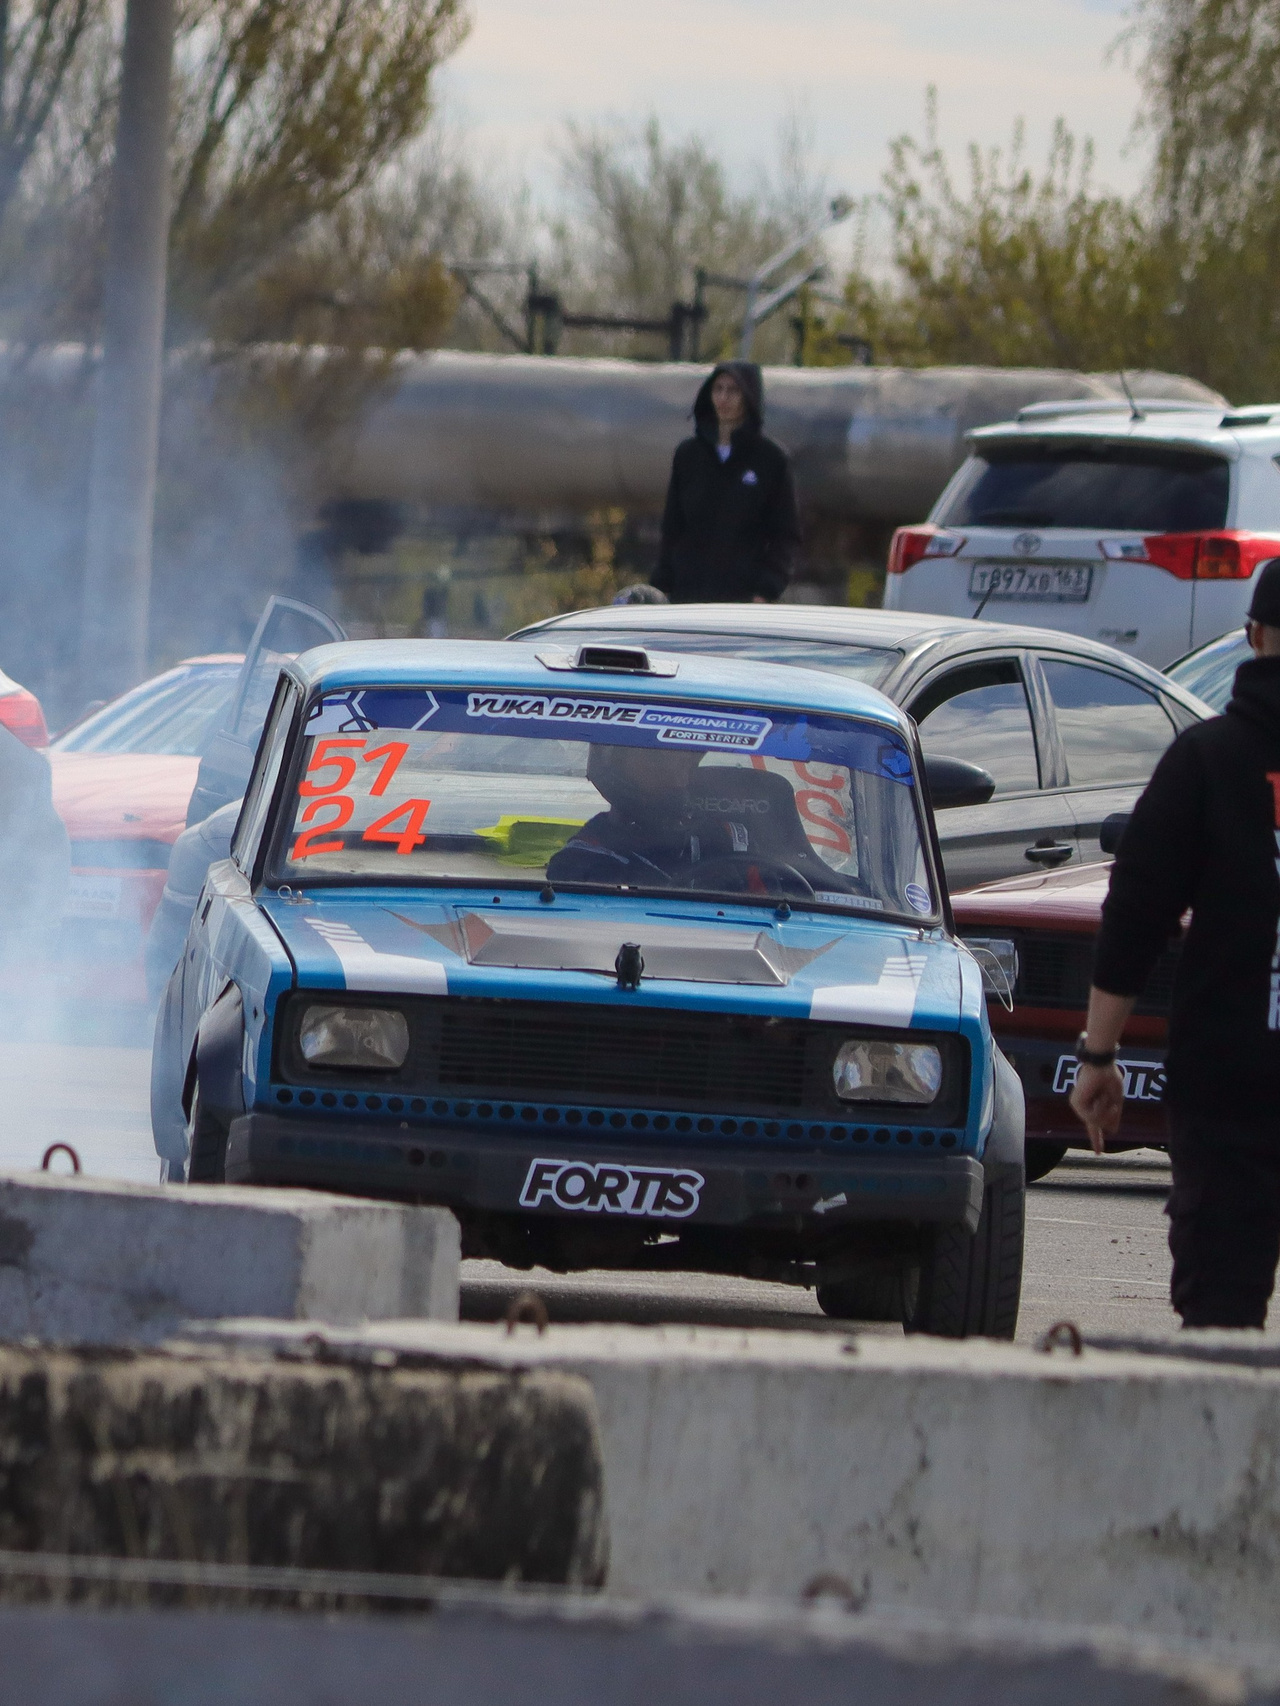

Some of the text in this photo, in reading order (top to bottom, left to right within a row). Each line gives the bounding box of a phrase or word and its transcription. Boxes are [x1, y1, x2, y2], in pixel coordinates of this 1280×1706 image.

[472, 697, 760, 732] YUKA DRIVE GYMKHANA LITE
[669, 730, 751, 745] FORTIS SERIES
[298, 738, 410, 797] 51
[291, 795, 432, 861] 24
[1052, 1055, 1168, 1101] FTIS
[521, 1159, 704, 1217] FORTIS
